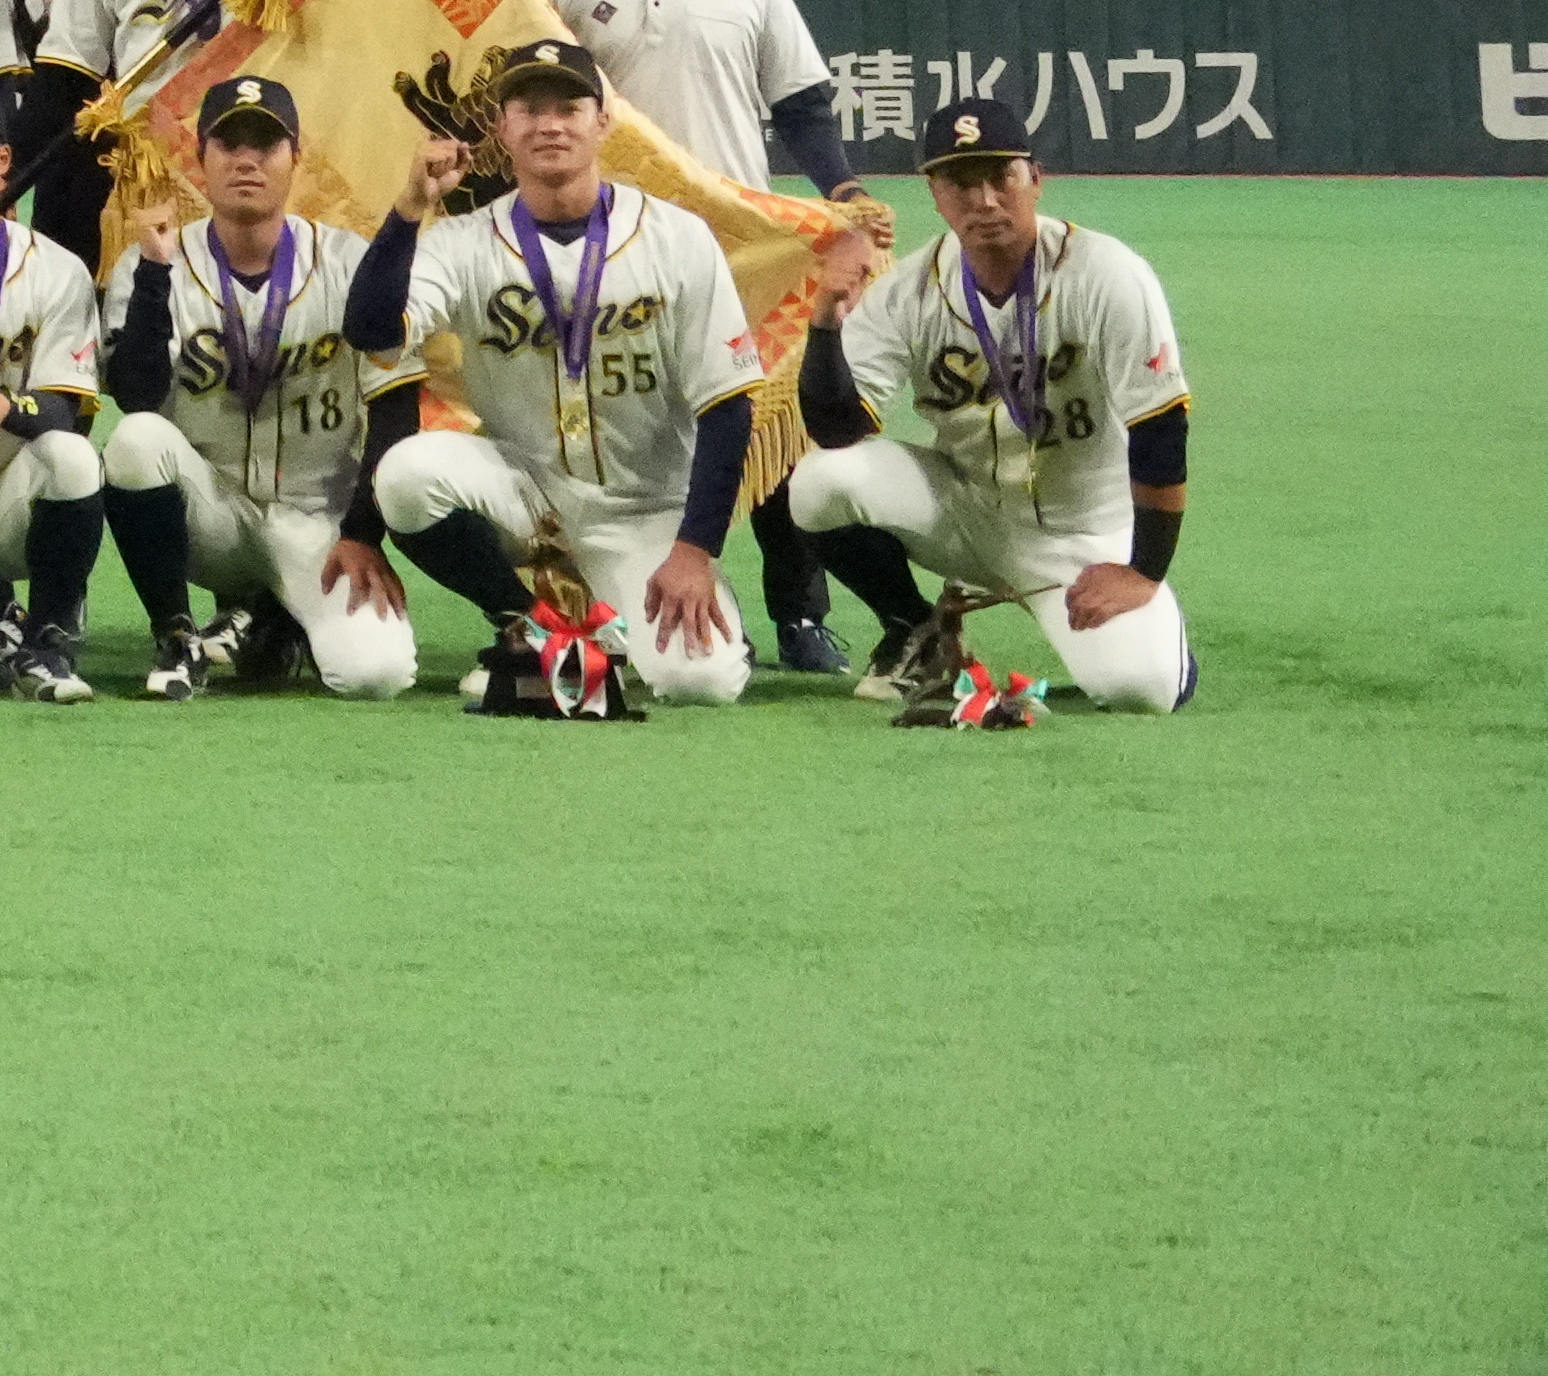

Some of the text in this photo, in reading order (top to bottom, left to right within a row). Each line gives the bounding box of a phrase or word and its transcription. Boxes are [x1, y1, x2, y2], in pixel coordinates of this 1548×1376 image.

[600, 353, 656, 397] 55
[292, 389, 343, 435] 18
[1041, 398, 1094, 448] 28
